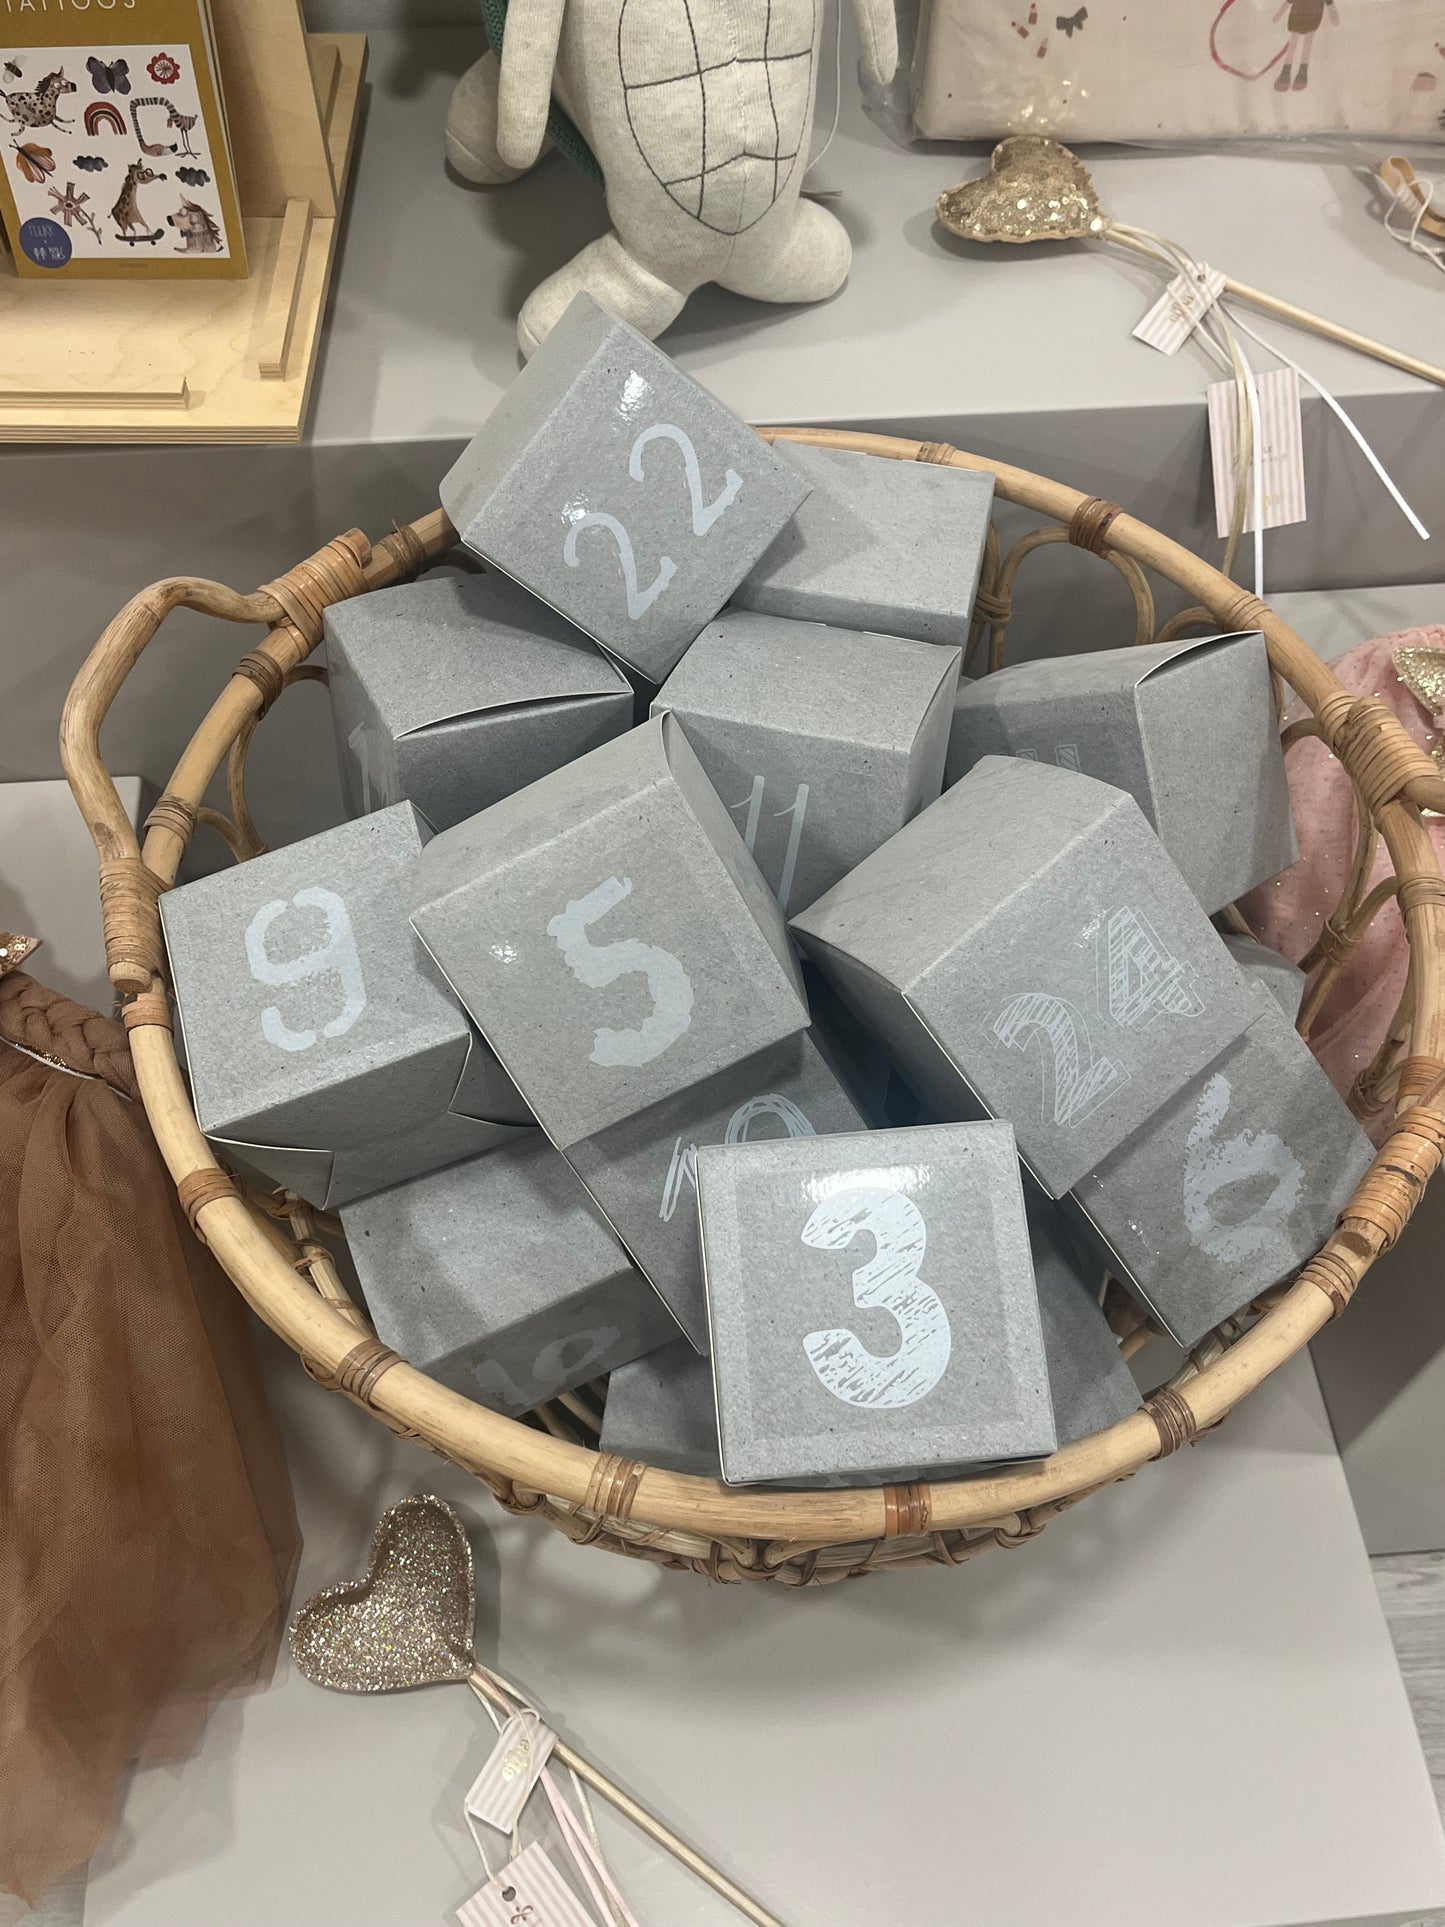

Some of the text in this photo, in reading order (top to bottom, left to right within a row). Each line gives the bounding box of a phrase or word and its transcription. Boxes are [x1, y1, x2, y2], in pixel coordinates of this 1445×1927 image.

[564, 423, 744, 620] 22
[245, 886, 367, 1051] 9
[547, 876, 695, 1067] 5
[983, 905, 1206, 1129] 24
[1183, 1072, 1306, 1262] 6
[801, 1187, 951, 1408] 3
